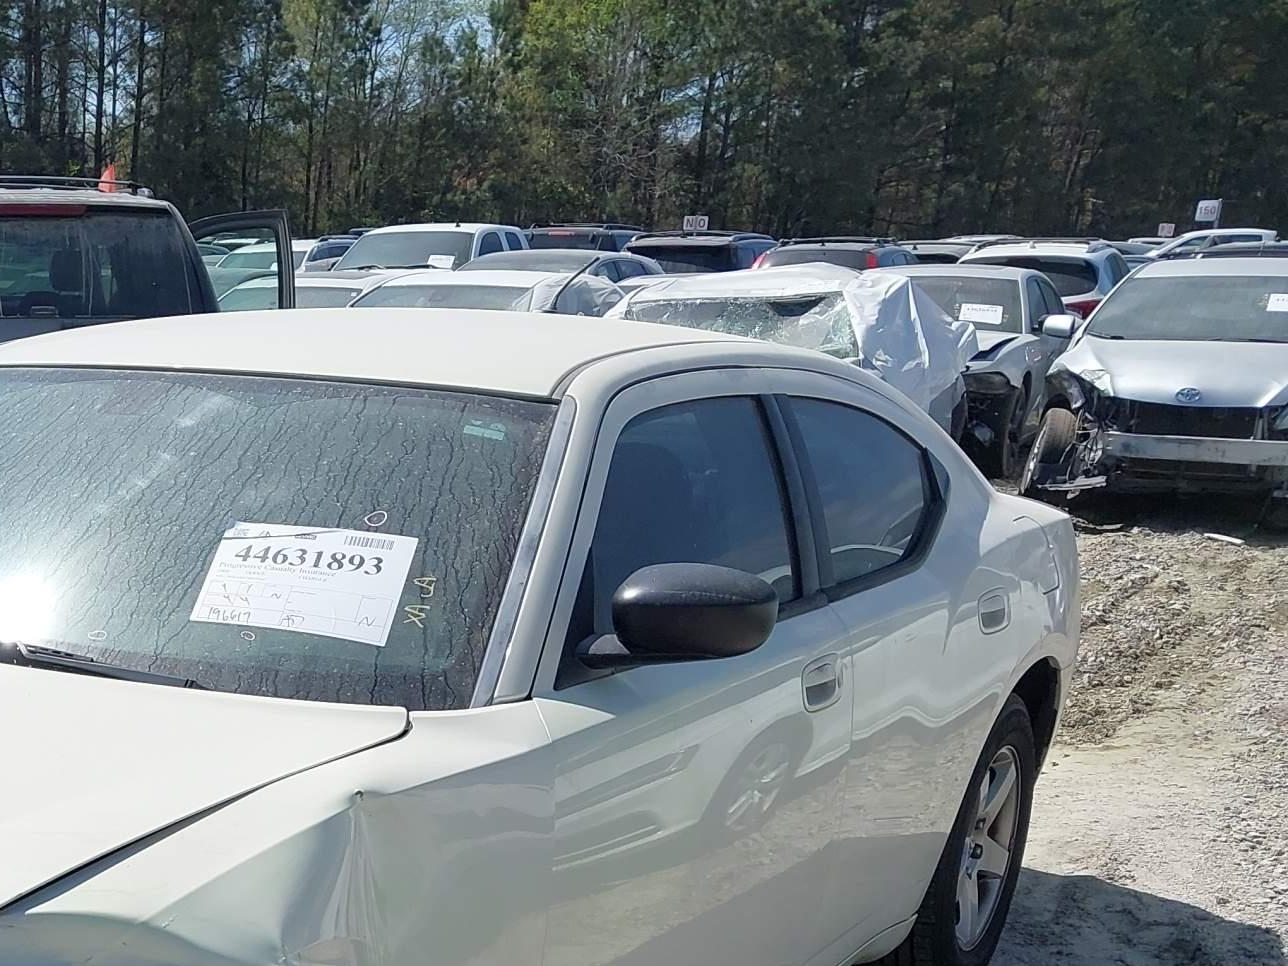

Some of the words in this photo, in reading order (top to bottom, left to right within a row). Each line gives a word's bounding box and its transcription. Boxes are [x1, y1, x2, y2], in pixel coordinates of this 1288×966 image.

[685, 218, 694, 228] N
[235, 544, 384, 576] 44631893
[299, 567, 337, 577] Insurance
